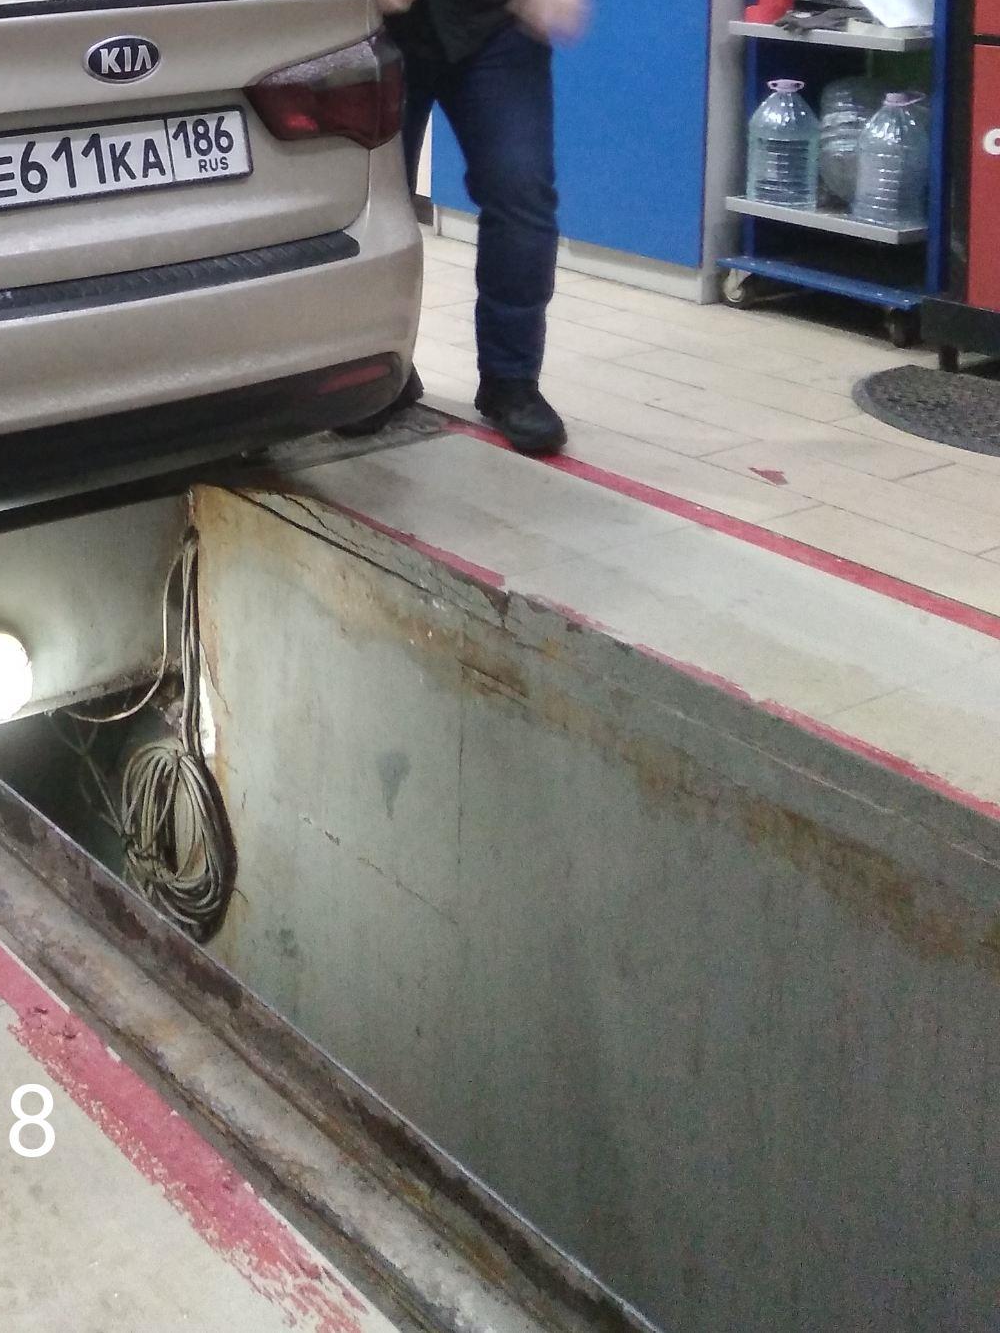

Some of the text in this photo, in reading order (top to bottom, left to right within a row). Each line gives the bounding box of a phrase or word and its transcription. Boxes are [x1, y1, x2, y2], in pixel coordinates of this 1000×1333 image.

[99, 44, 152, 74] KIA
[171, 115, 235, 159] 186
[197, 156, 229, 174] RUS
